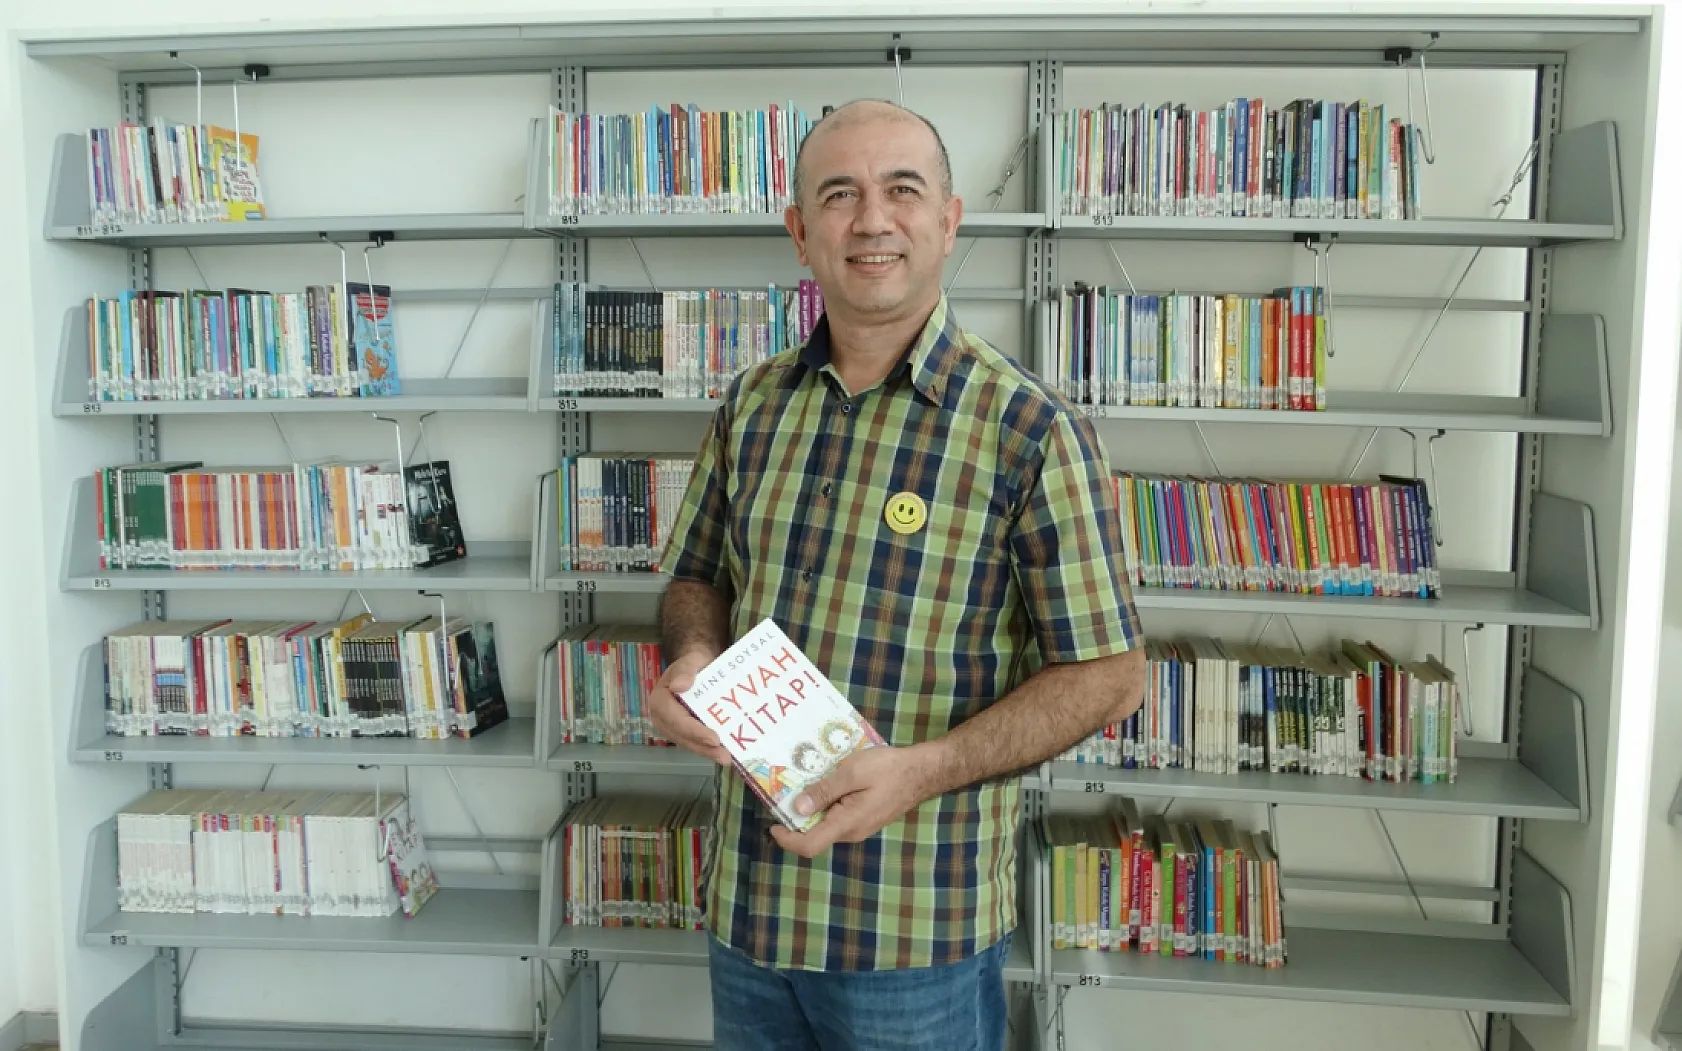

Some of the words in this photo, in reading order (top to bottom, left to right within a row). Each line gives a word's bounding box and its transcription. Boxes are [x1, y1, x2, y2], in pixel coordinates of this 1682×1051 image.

[562, 215, 578, 224] 813
[1093, 215, 1112, 225] 813
[83, 403, 101, 412] 813
[558, 399, 577, 410] 813
[94, 579, 110, 587] 813
[577, 580, 596, 591] 813
[728, 632, 775, 670] SOYSAL
[706, 646, 798, 726] EYVAH
[729, 670, 820, 751] KİTAP!
[104, 751, 123, 761] 813
[574, 761, 592, 771] 813
[1085, 782, 1104, 793] 813
[571, 949, 588, 959] 813
[1079, 974, 1100, 985] 813
